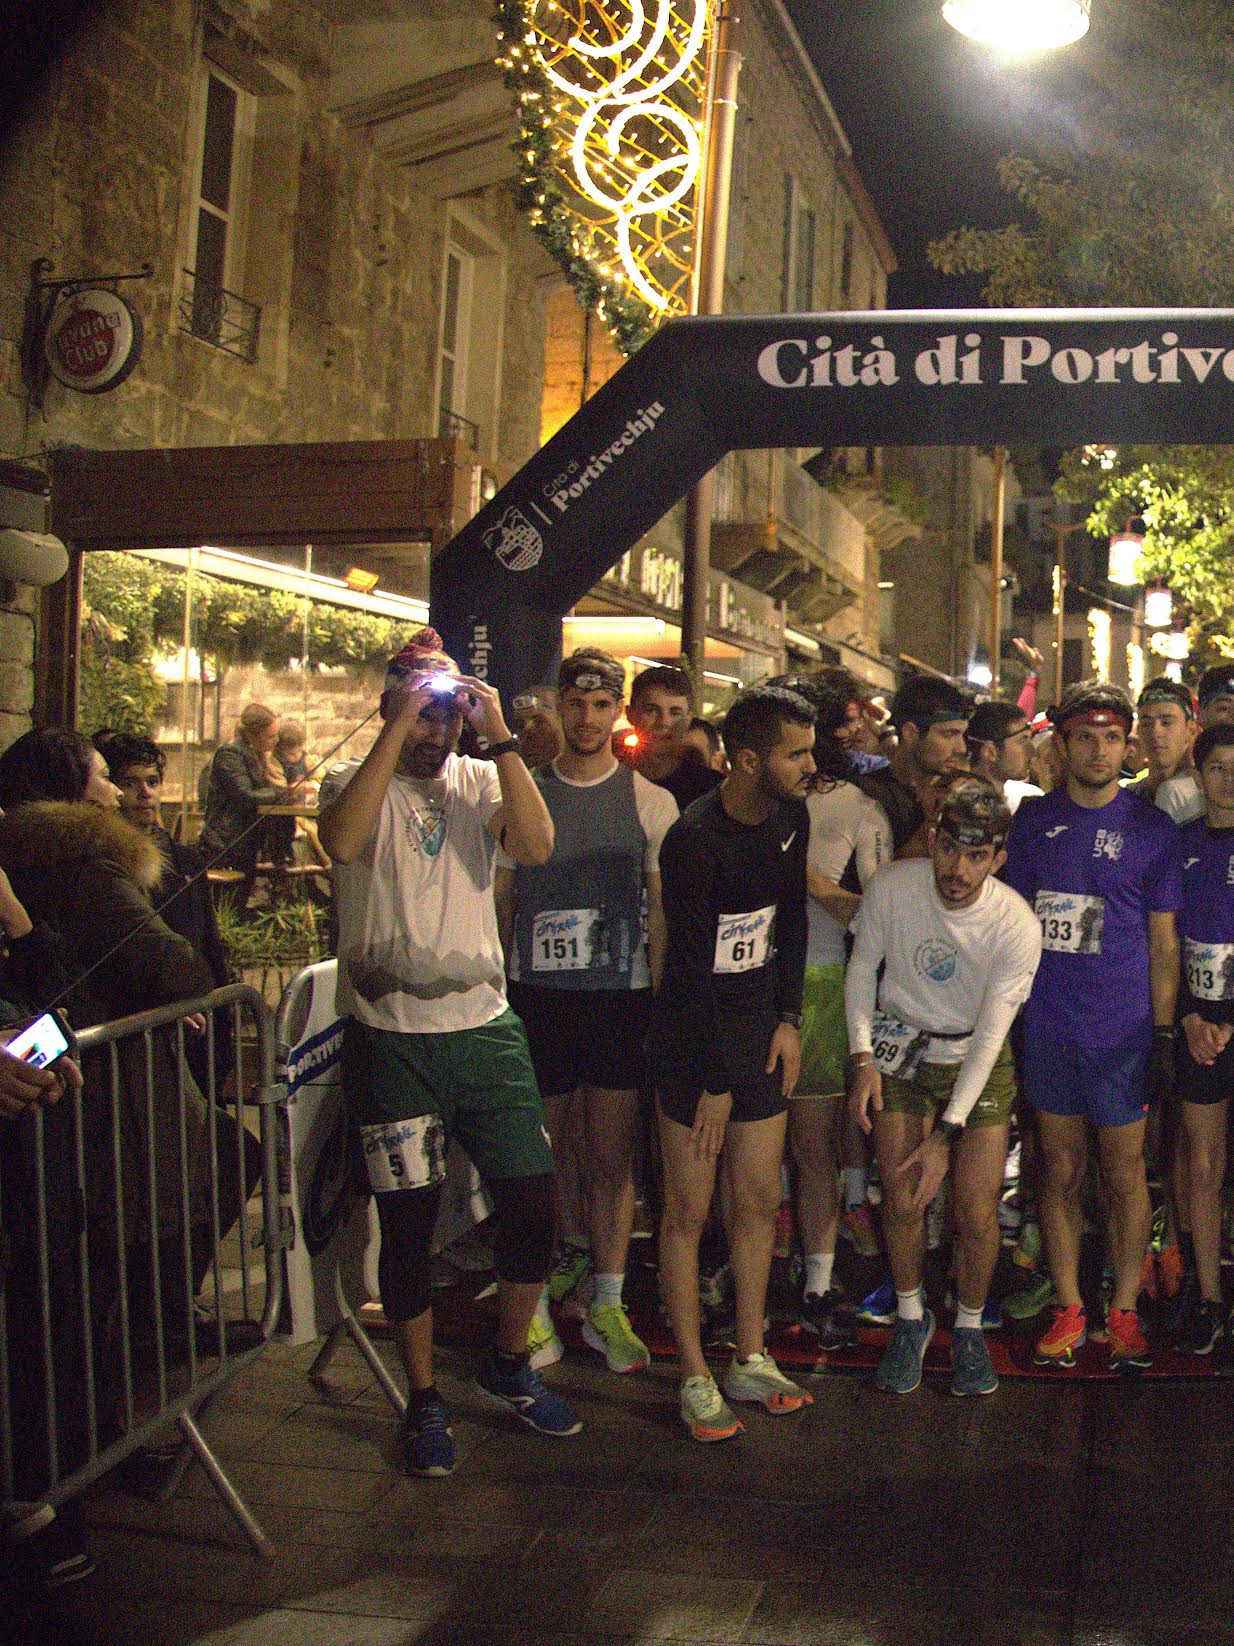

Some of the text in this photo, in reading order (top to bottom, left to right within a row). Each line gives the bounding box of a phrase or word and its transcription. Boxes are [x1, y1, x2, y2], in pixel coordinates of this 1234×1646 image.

[757, 335, 900, 388] Cità
[915, 333, 983, 385] di
[551, 400, 666, 513] Portivechju
[1092, 829, 1107, 857] UCB
[1040, 917, 1072, 941] 133
[541, 938, 579, 958] 151
[732, 938, 755, 961] 61
[388, 1153, 405, 1177] 5
